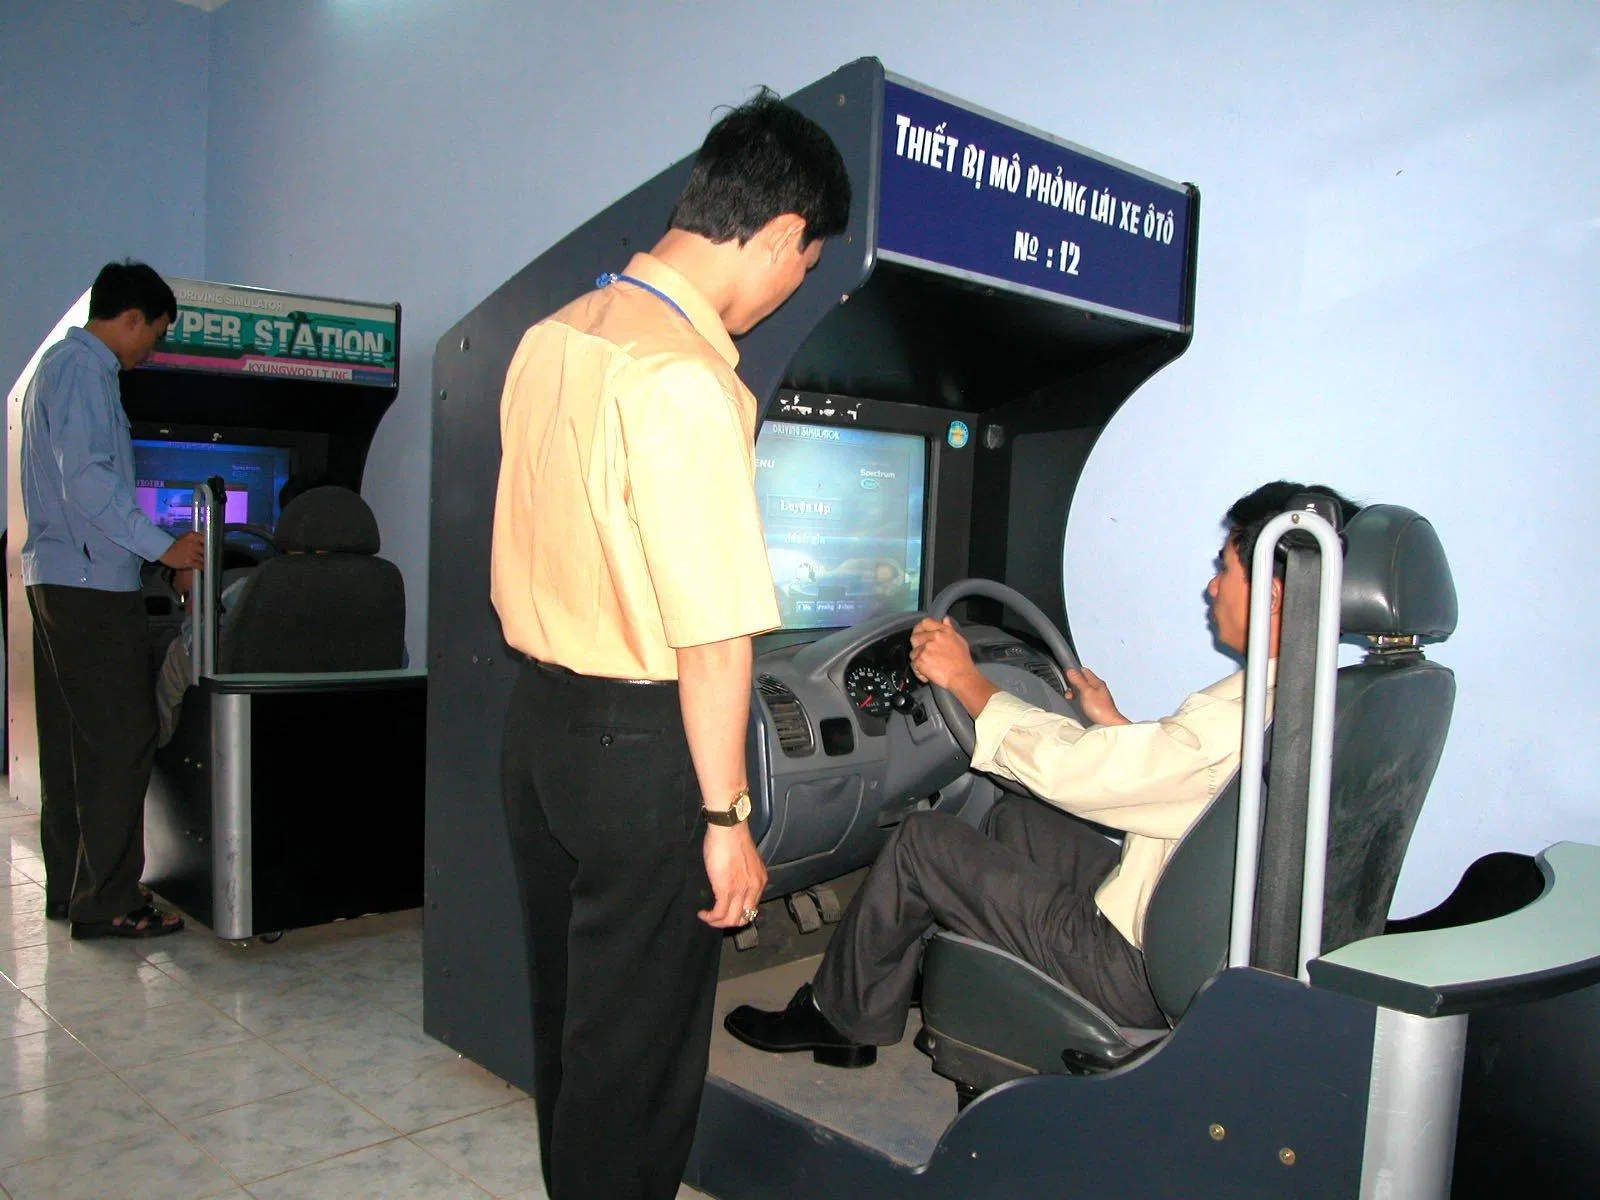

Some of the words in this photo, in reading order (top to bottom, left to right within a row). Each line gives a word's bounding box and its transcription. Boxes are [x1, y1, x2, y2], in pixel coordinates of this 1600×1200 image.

[896, 114, 959, 173] THIẾT
[962, 144, 986, 190] BỊ
[989, 152, 1021, 193] MÔ
[1025, 165, 1087, 216] PHỎNG
[1090, 187, 1116, 226] LÁI
[1119, 200, 1141, 234] XE
[1143, 202, 1175, 245] ÔTÔ
[1059, 240, 1082, 276] 12
[179, 289, 225, 304] DRIVING
[227, 294, 285, 311] SIMULATOR
[166, 309, 242, 348] YPER
[254, 317, 384, 362] STATION
[248, 362, 314, 377] KYUNGWOO
[755, 458, 776, 469] ENU
[859, 468, 896, 479] Spectrum
